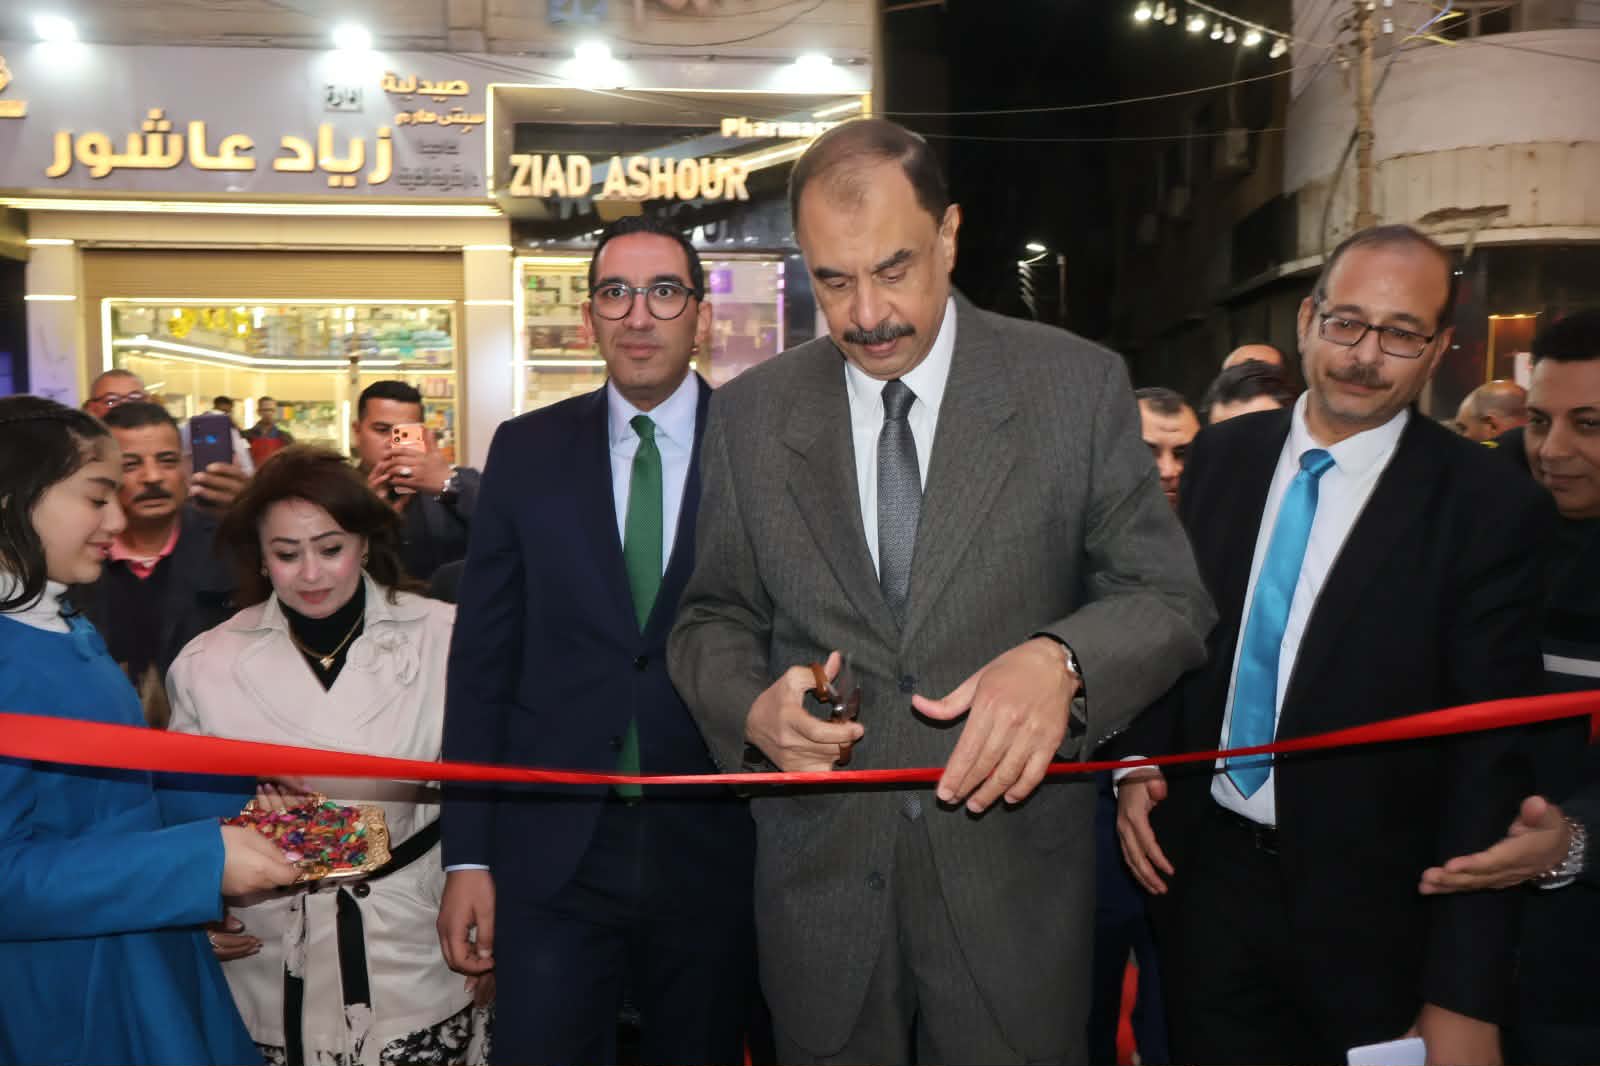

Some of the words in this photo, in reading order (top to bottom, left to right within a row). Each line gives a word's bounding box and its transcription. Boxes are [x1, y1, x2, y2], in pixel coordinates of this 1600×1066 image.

[381, 70, 470, 102] صيدلية
[46, 108, 257, 178] عاشور
[721, 117, 842, 138] Pharmac
[272, 124, 393, 188] زياد
[509, 154, 592, 198] ZIAD
[602, 156, 750, 201] ASHOUR
